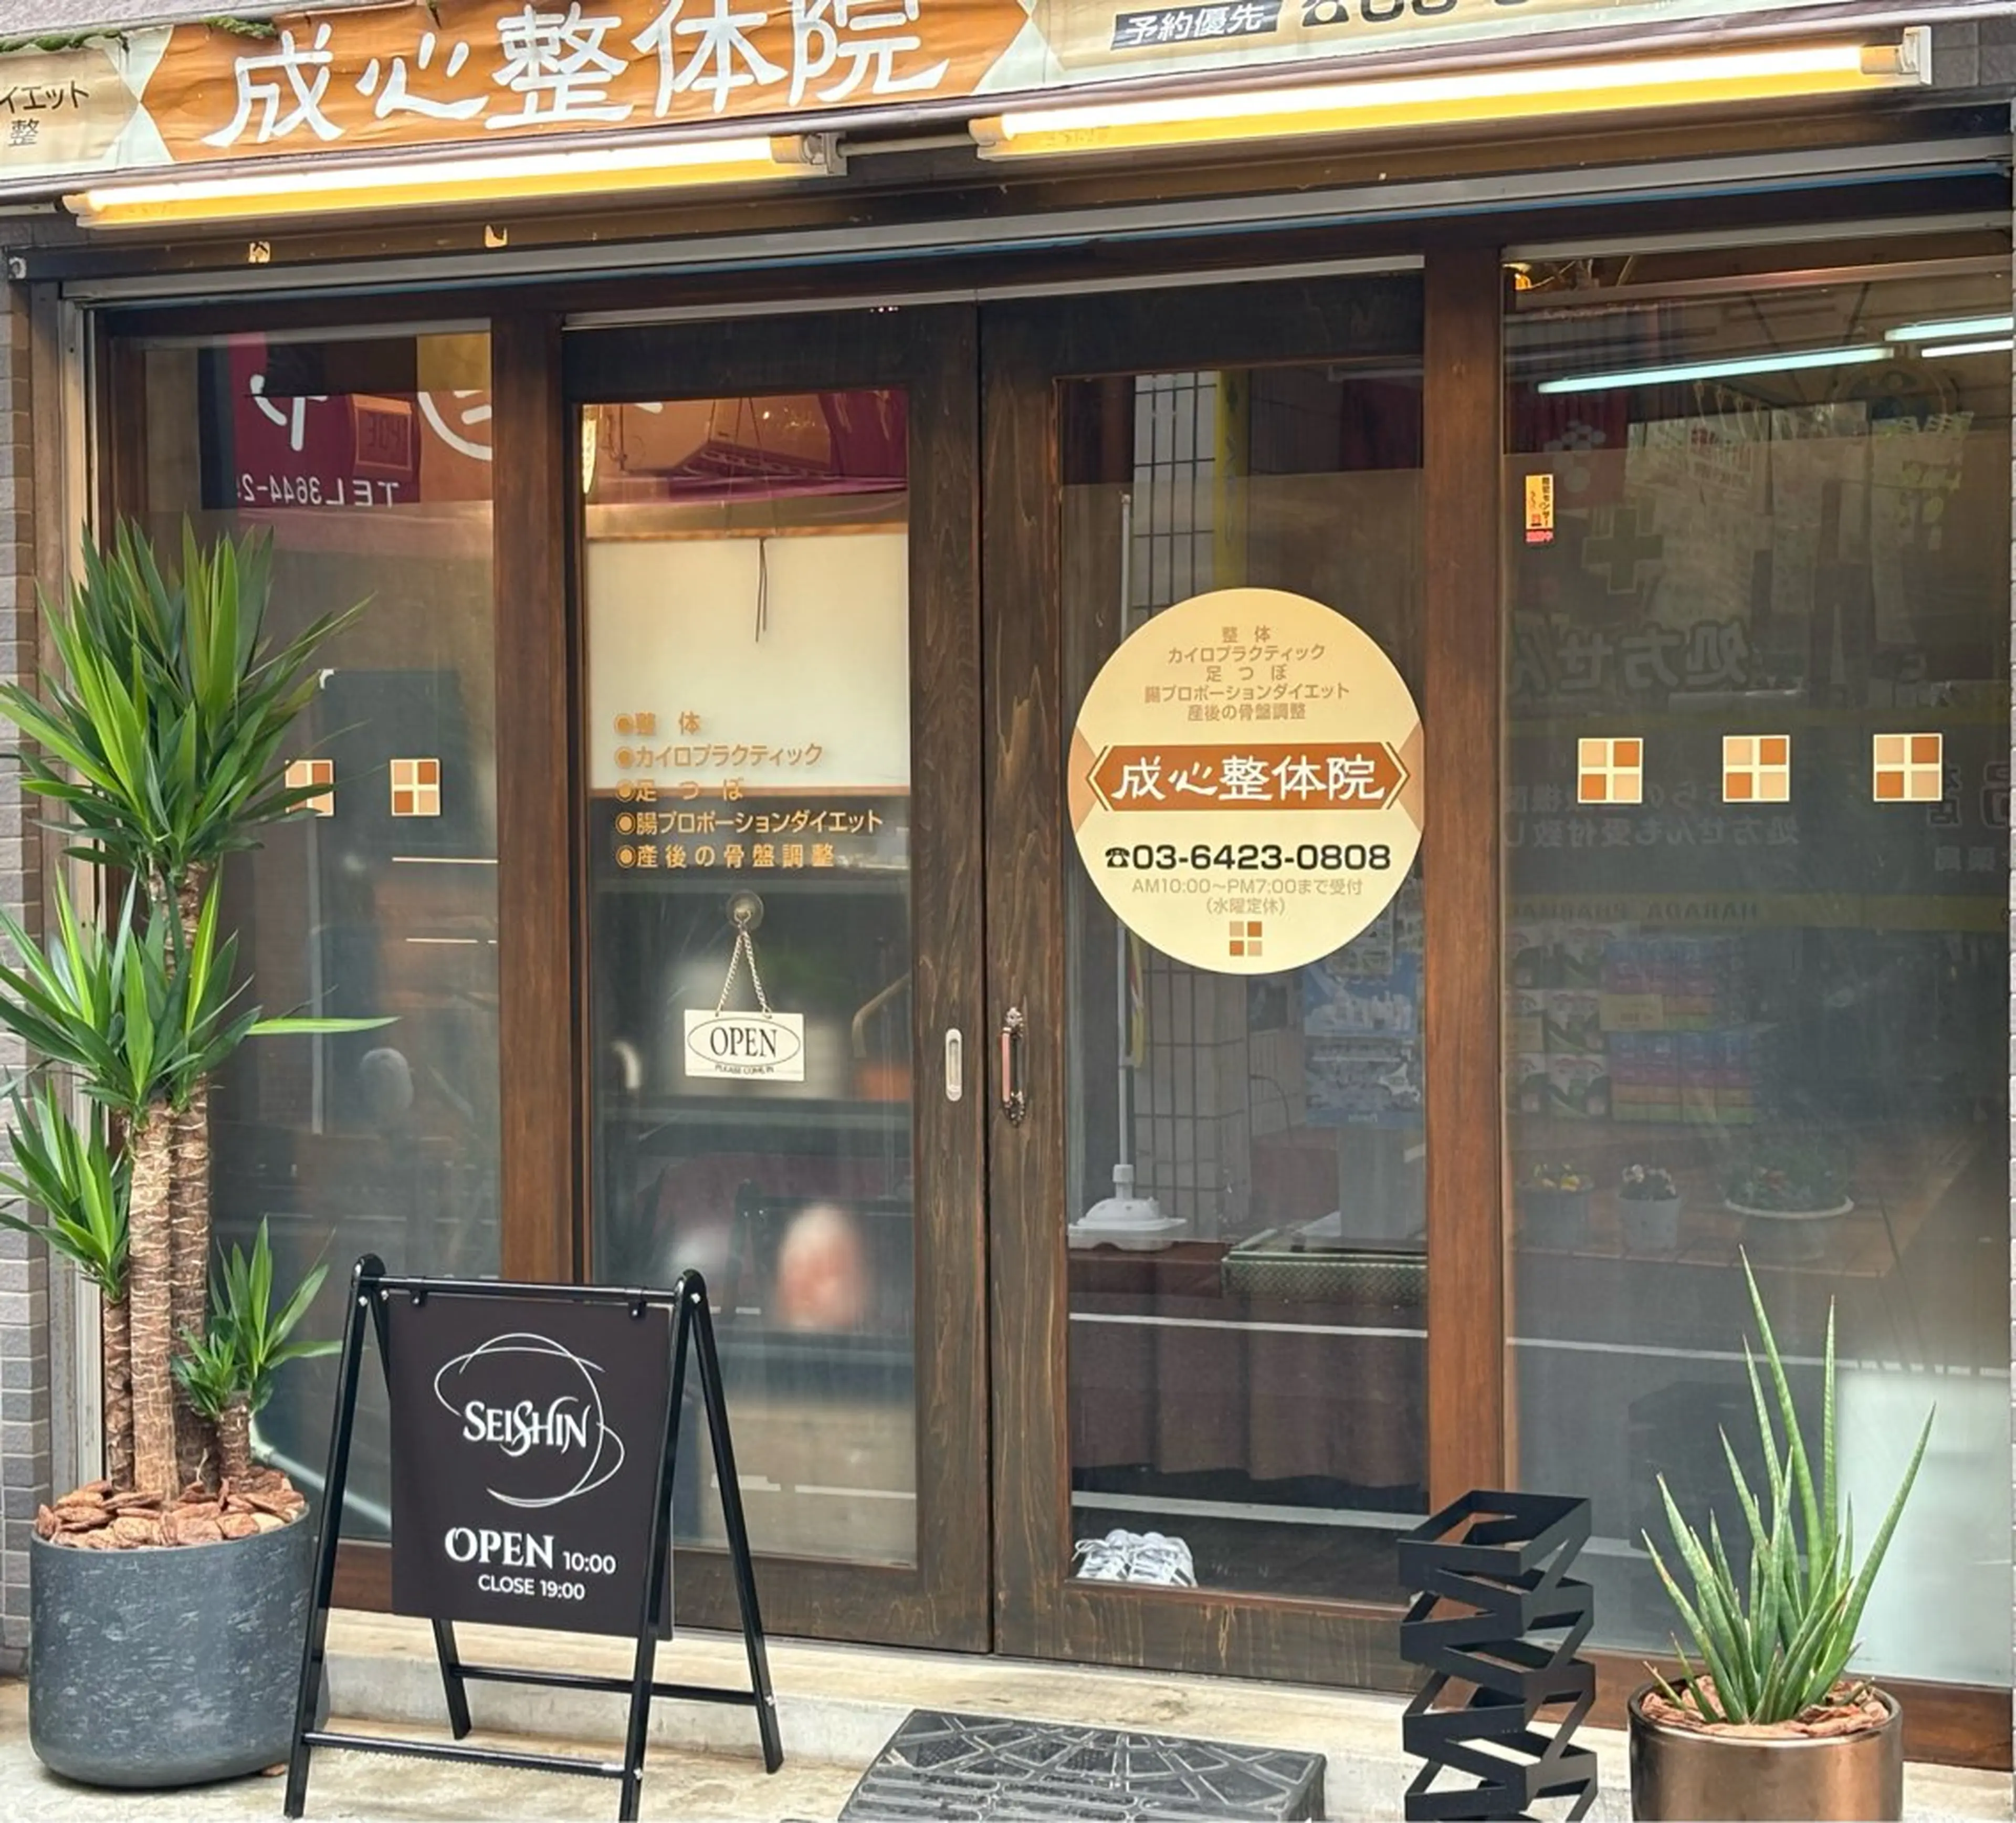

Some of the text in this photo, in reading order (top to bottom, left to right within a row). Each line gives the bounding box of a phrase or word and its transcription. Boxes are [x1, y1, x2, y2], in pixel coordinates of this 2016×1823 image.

[1127, 3, 1265, 43] 予約優先
[203, 0, 949, 146] 成心整体院
[1222, 626, 1270, 643] 整体
[1168, 644, 1325, 664] カイロプラクティック
[1206, 664, 1287, 682] 足つぼ
[1188, 703, 1306, 721] 産後の骨盤調整
[636, 743, 823, 768] カイロプラクティック
[1111, 753, 1385, 801] 成心整体院
[636, 809, 883, 835] 腸プロポーションダイエット
[637, 843, 834, 868] 産後の骨盤調整
[1133, 844, 1390, 869] 03-6423-0808
[710, 1026, 777, 1057] OPEN
[463, 1396, 590, 1457] SEISHIN
[445, 1527, 616, 1574] OPEN 10:00
[478, 1575, 585, 1600] CLOSE 19:00
